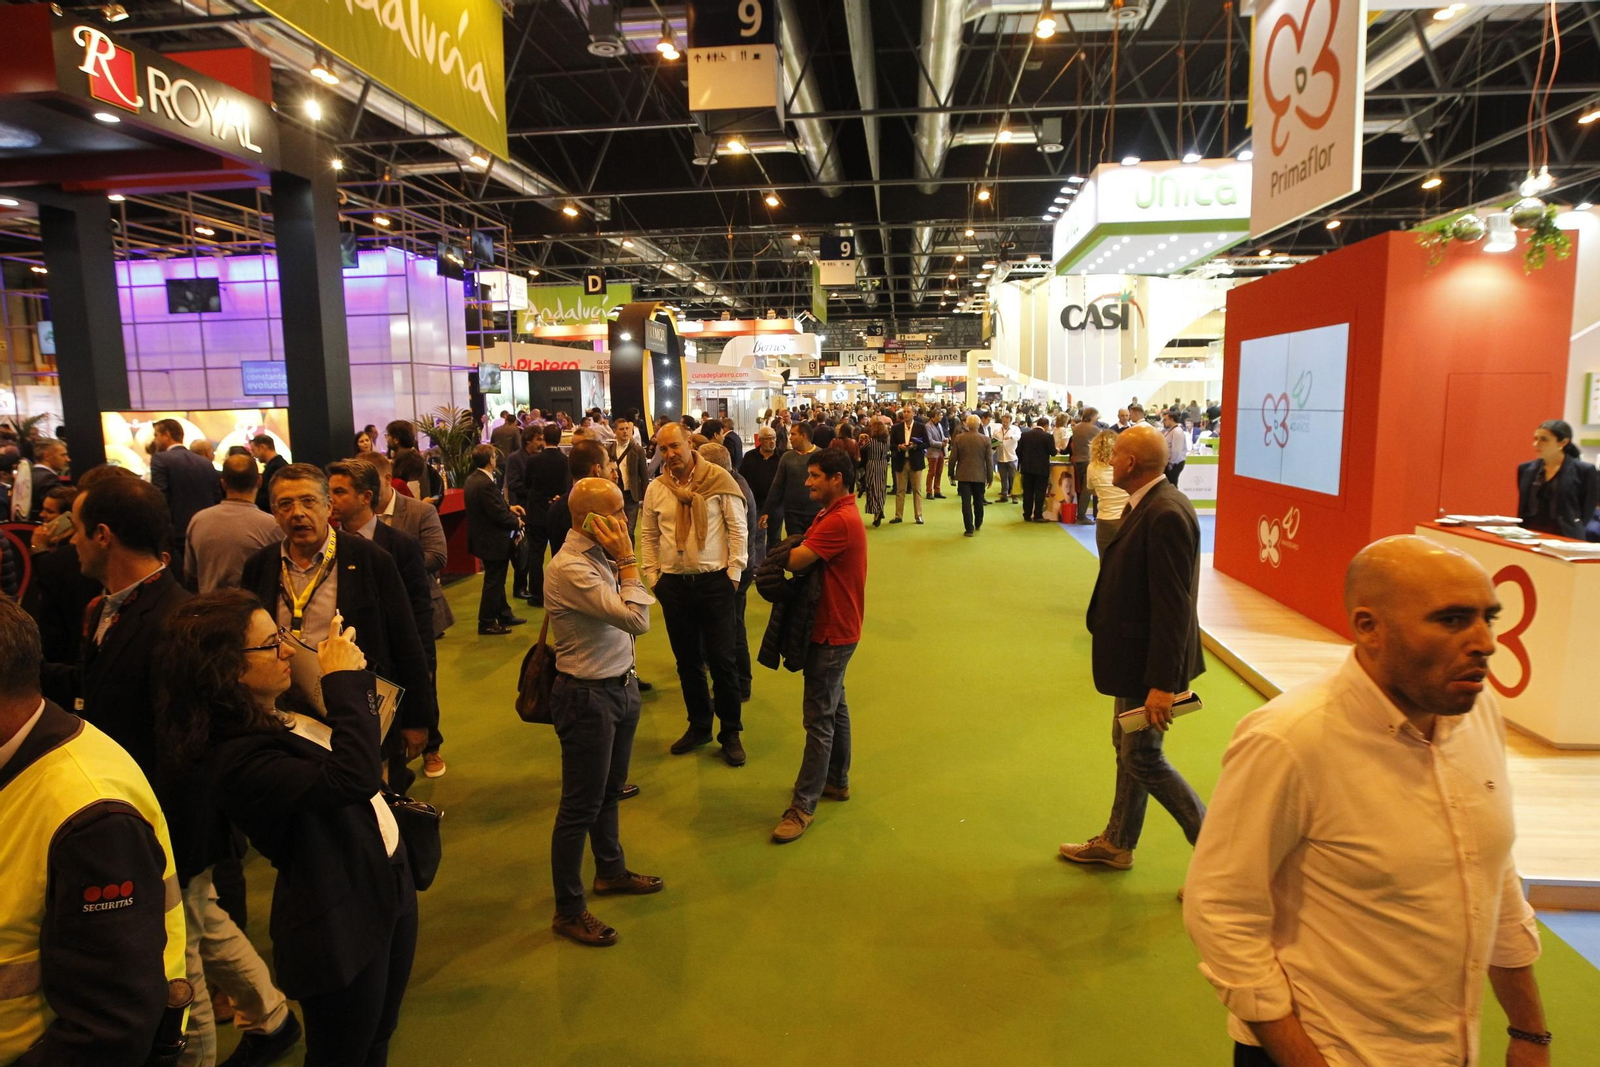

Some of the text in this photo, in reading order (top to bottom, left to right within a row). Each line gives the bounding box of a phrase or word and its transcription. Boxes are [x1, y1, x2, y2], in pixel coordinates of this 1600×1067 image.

[738, 0, 763, 37] 9
[324, 0, 500, 124] alucía
[147, 66, 262, 153] ROYAL
[1271, 142, 1335, 198] Primaflor
[840, 241, 851, 257] 9
[588, 275, 602, 292] D
[523, 295, 620, 323] Andalucía
[1060, 303, 1129, 330] CASI
[876, 327, 882, 336] 9
[691, 371, 749, 379] cunadeplatero.com
[83, 897, 133, 912] SECURITAS
